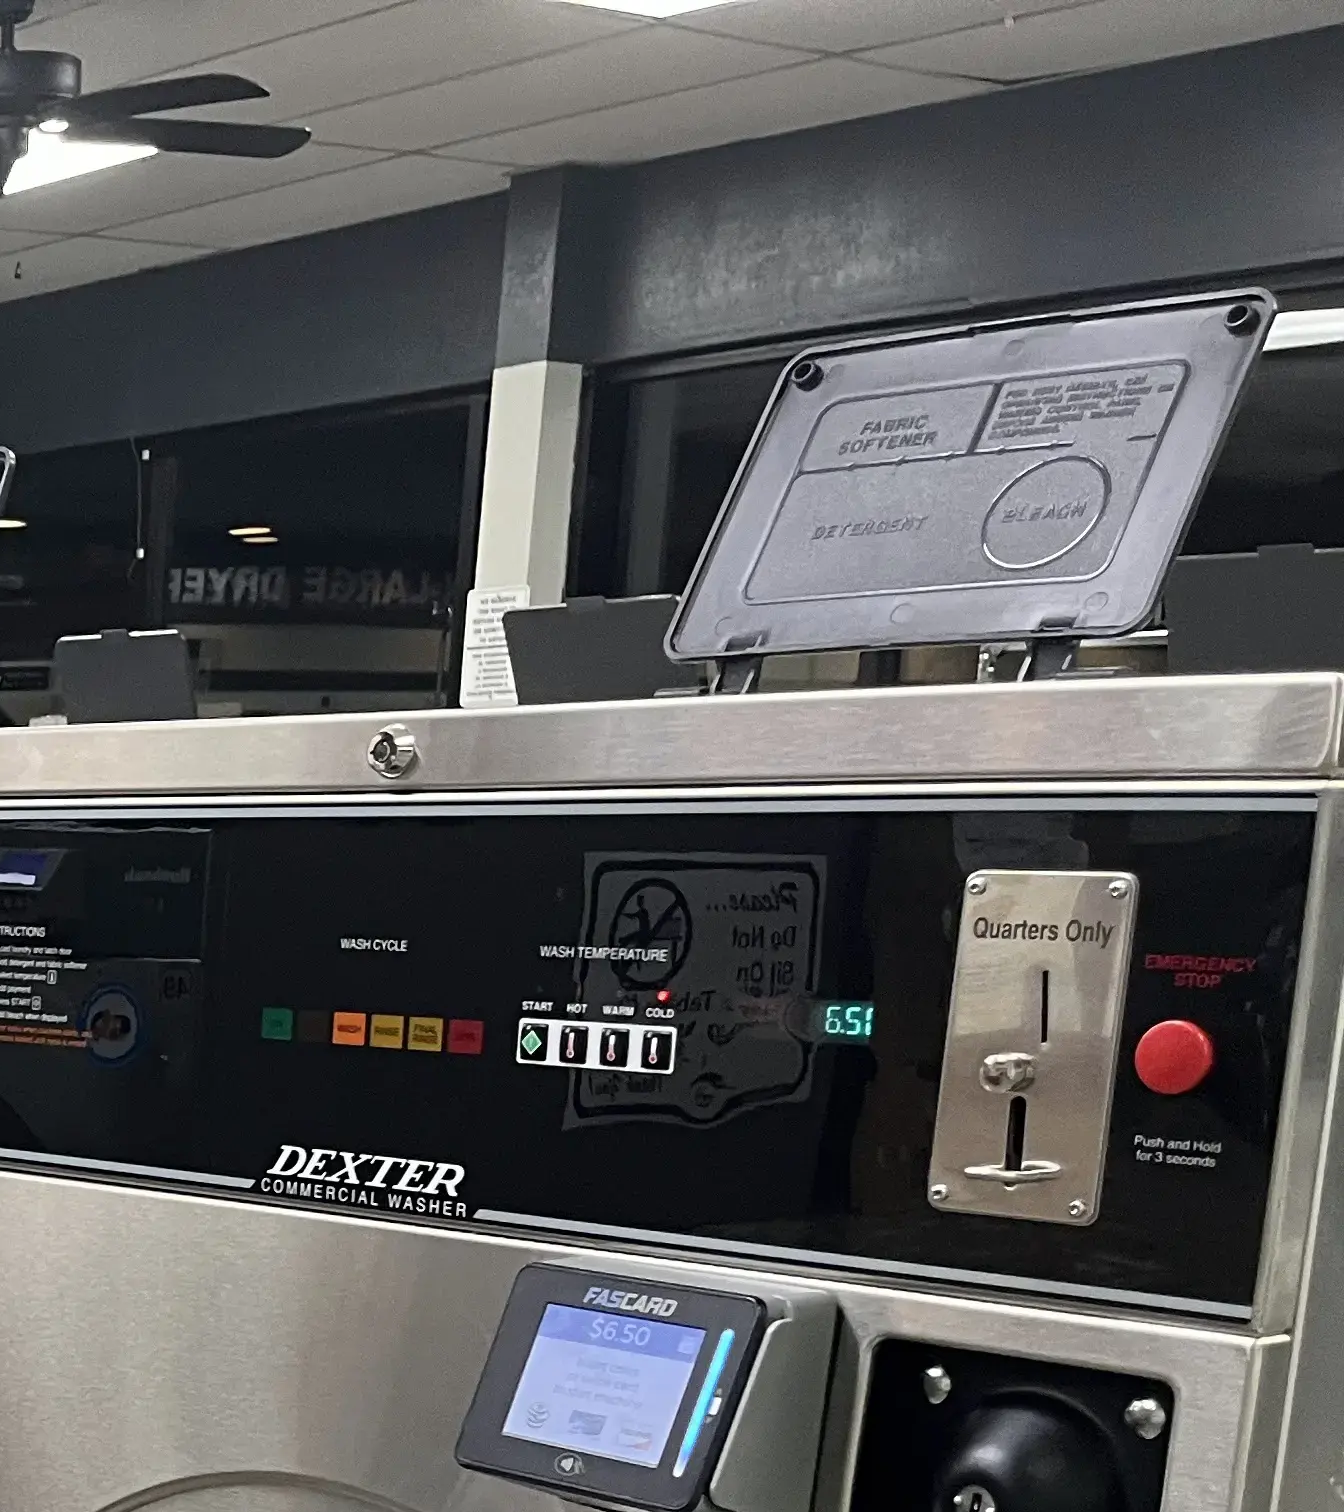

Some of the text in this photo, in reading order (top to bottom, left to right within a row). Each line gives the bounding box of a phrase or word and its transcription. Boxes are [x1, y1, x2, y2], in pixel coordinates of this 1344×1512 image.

[860, 414, 930, 436] FABRIC
[838, 431, 940, 456] SOFTENER
[1000, 500, 1090, 523] BLEACH
[810, 515, 930, 541] DETERGENT
[973, 917, 1116, 949] Quarters Only
[340, 938, 408, 952] WASH CYCLE
[540, 945, 669, 962] WASH TEMPERATURE
[1144, 954, 1257, 973] EMERGENCY
[1173, 972, 1222, 988] STOP
[522, 1001, 675, 1019] START HOT WARM COLD
[1134, 1135, 1222, 1153] Push and Hold
[1136, 1149, 1217, 1168] for 3 seconds
[266, 1144, 465, 1197] DEXTER
[261, 1177, 467, 1218] COMMERCIAL WASHER
[583, 1287, 679, 1317] FASCARD
[588, 1317, 652, 1346] $6.50
